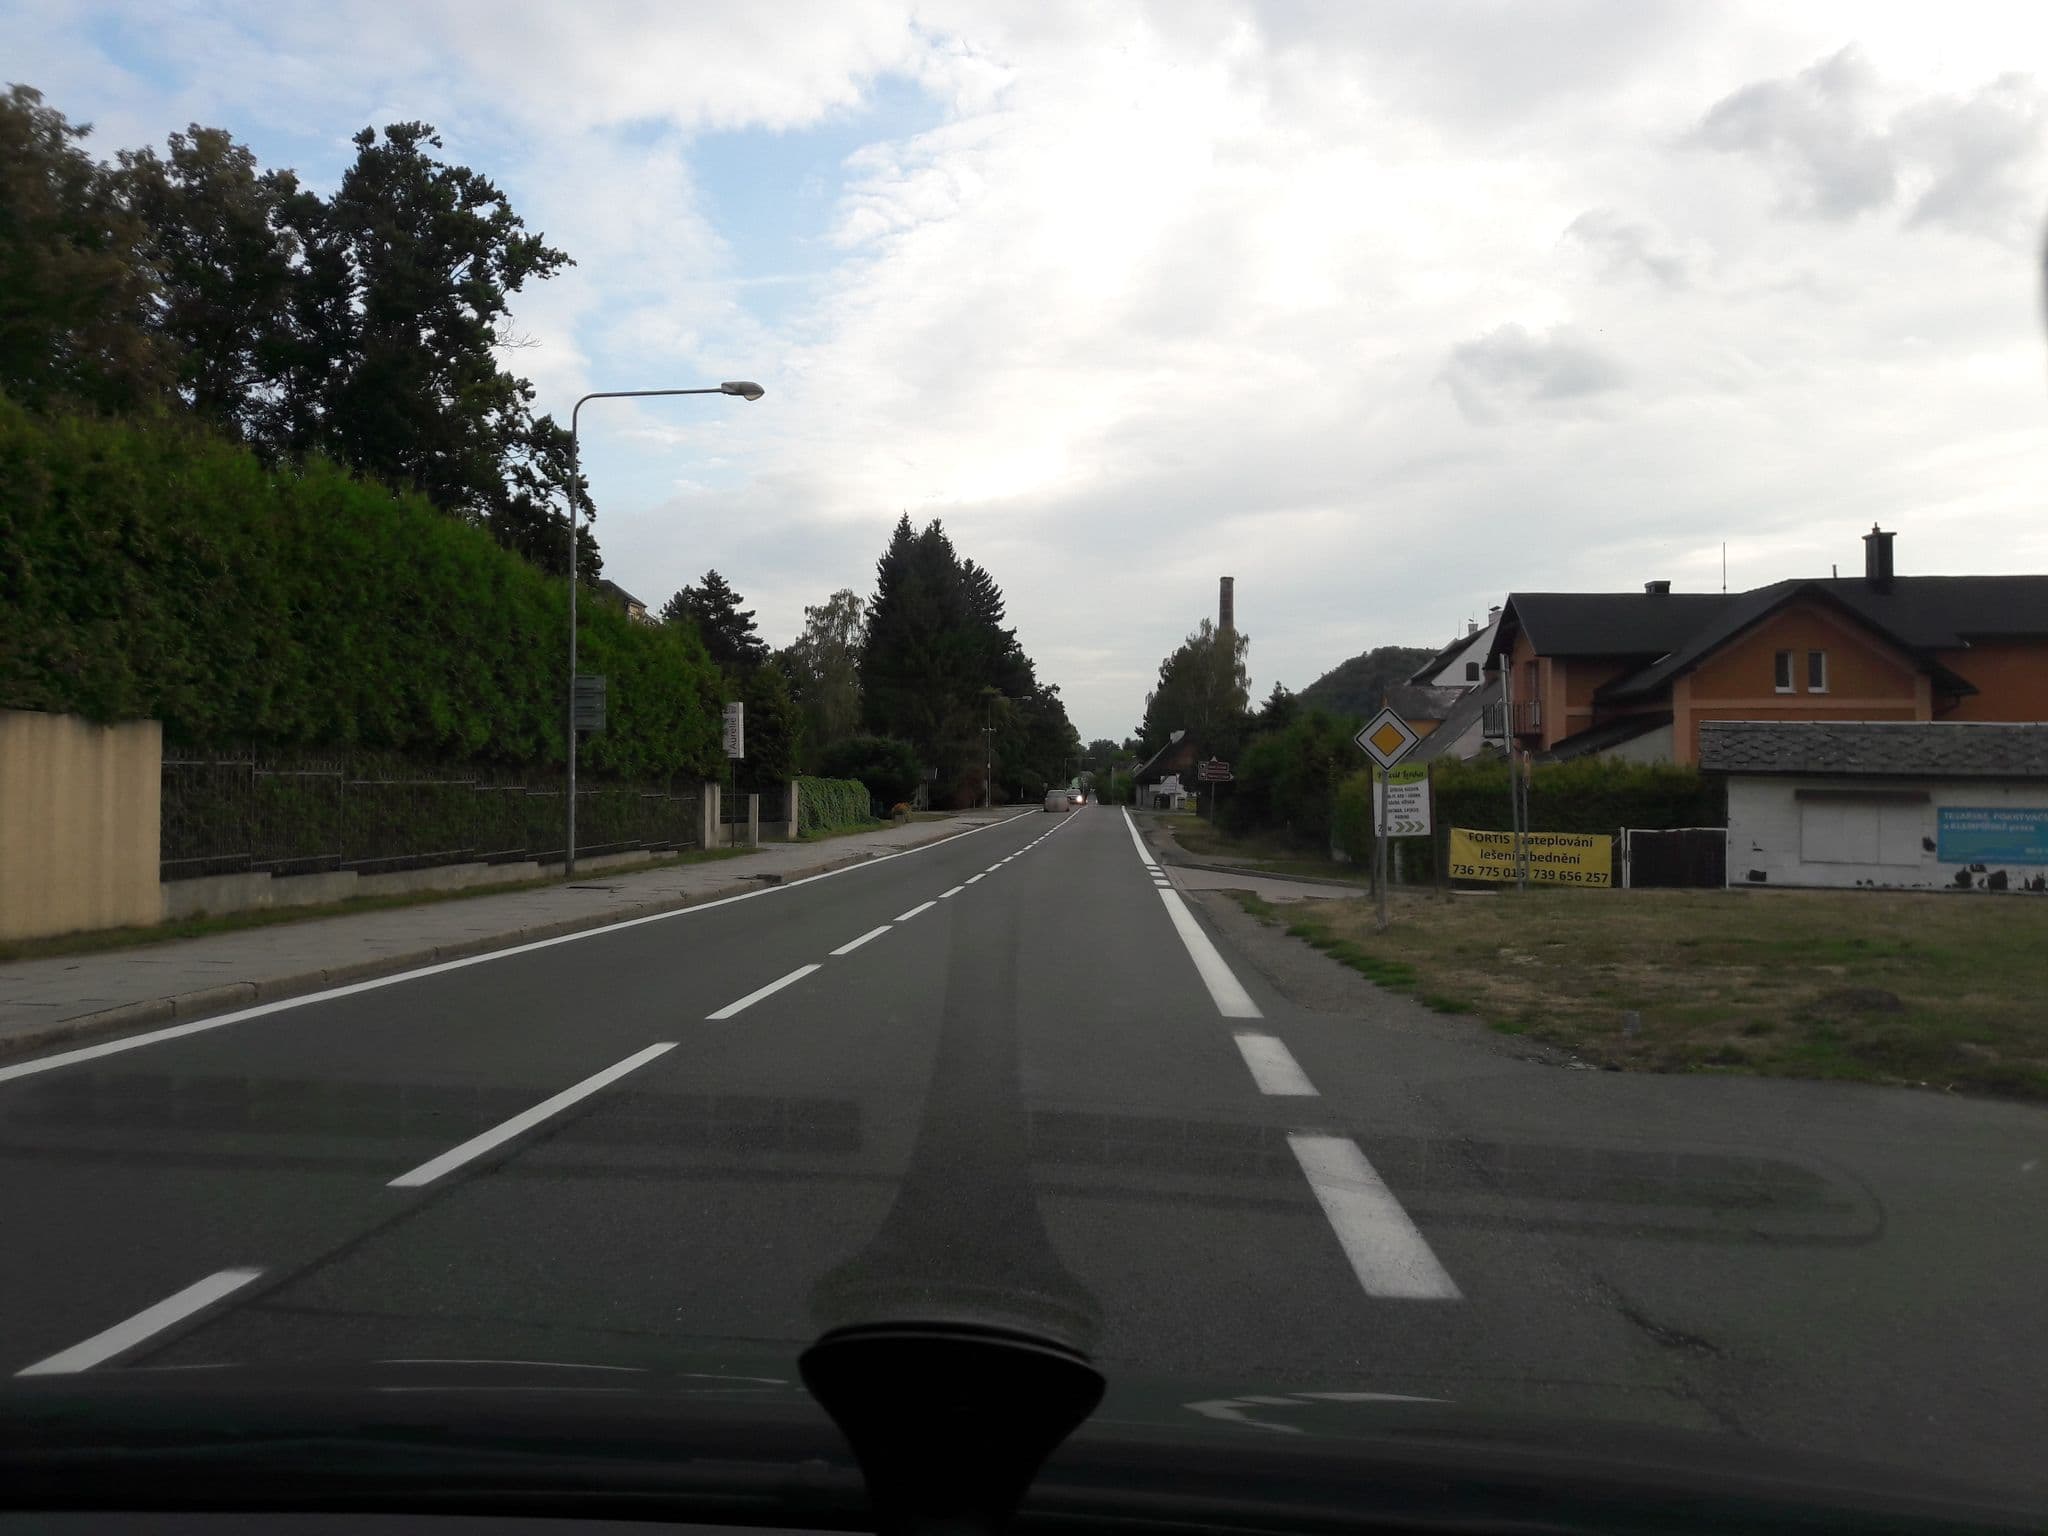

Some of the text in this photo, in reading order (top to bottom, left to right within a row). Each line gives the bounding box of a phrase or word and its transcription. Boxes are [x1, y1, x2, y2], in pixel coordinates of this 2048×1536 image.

[1468, 832, 1510, 844] FORTIS
[1480, 848, 1515, 861] lešení
[1529, 850, 1581, 864] bednění
[1452, 864, 1474, 875] 736
[1478, 865, 1500, 877] 775
[1533, 869, 1555, 880] 739
[1559, 870, 1582, 882] 656
[1585, 872, 1608, 883] 257
